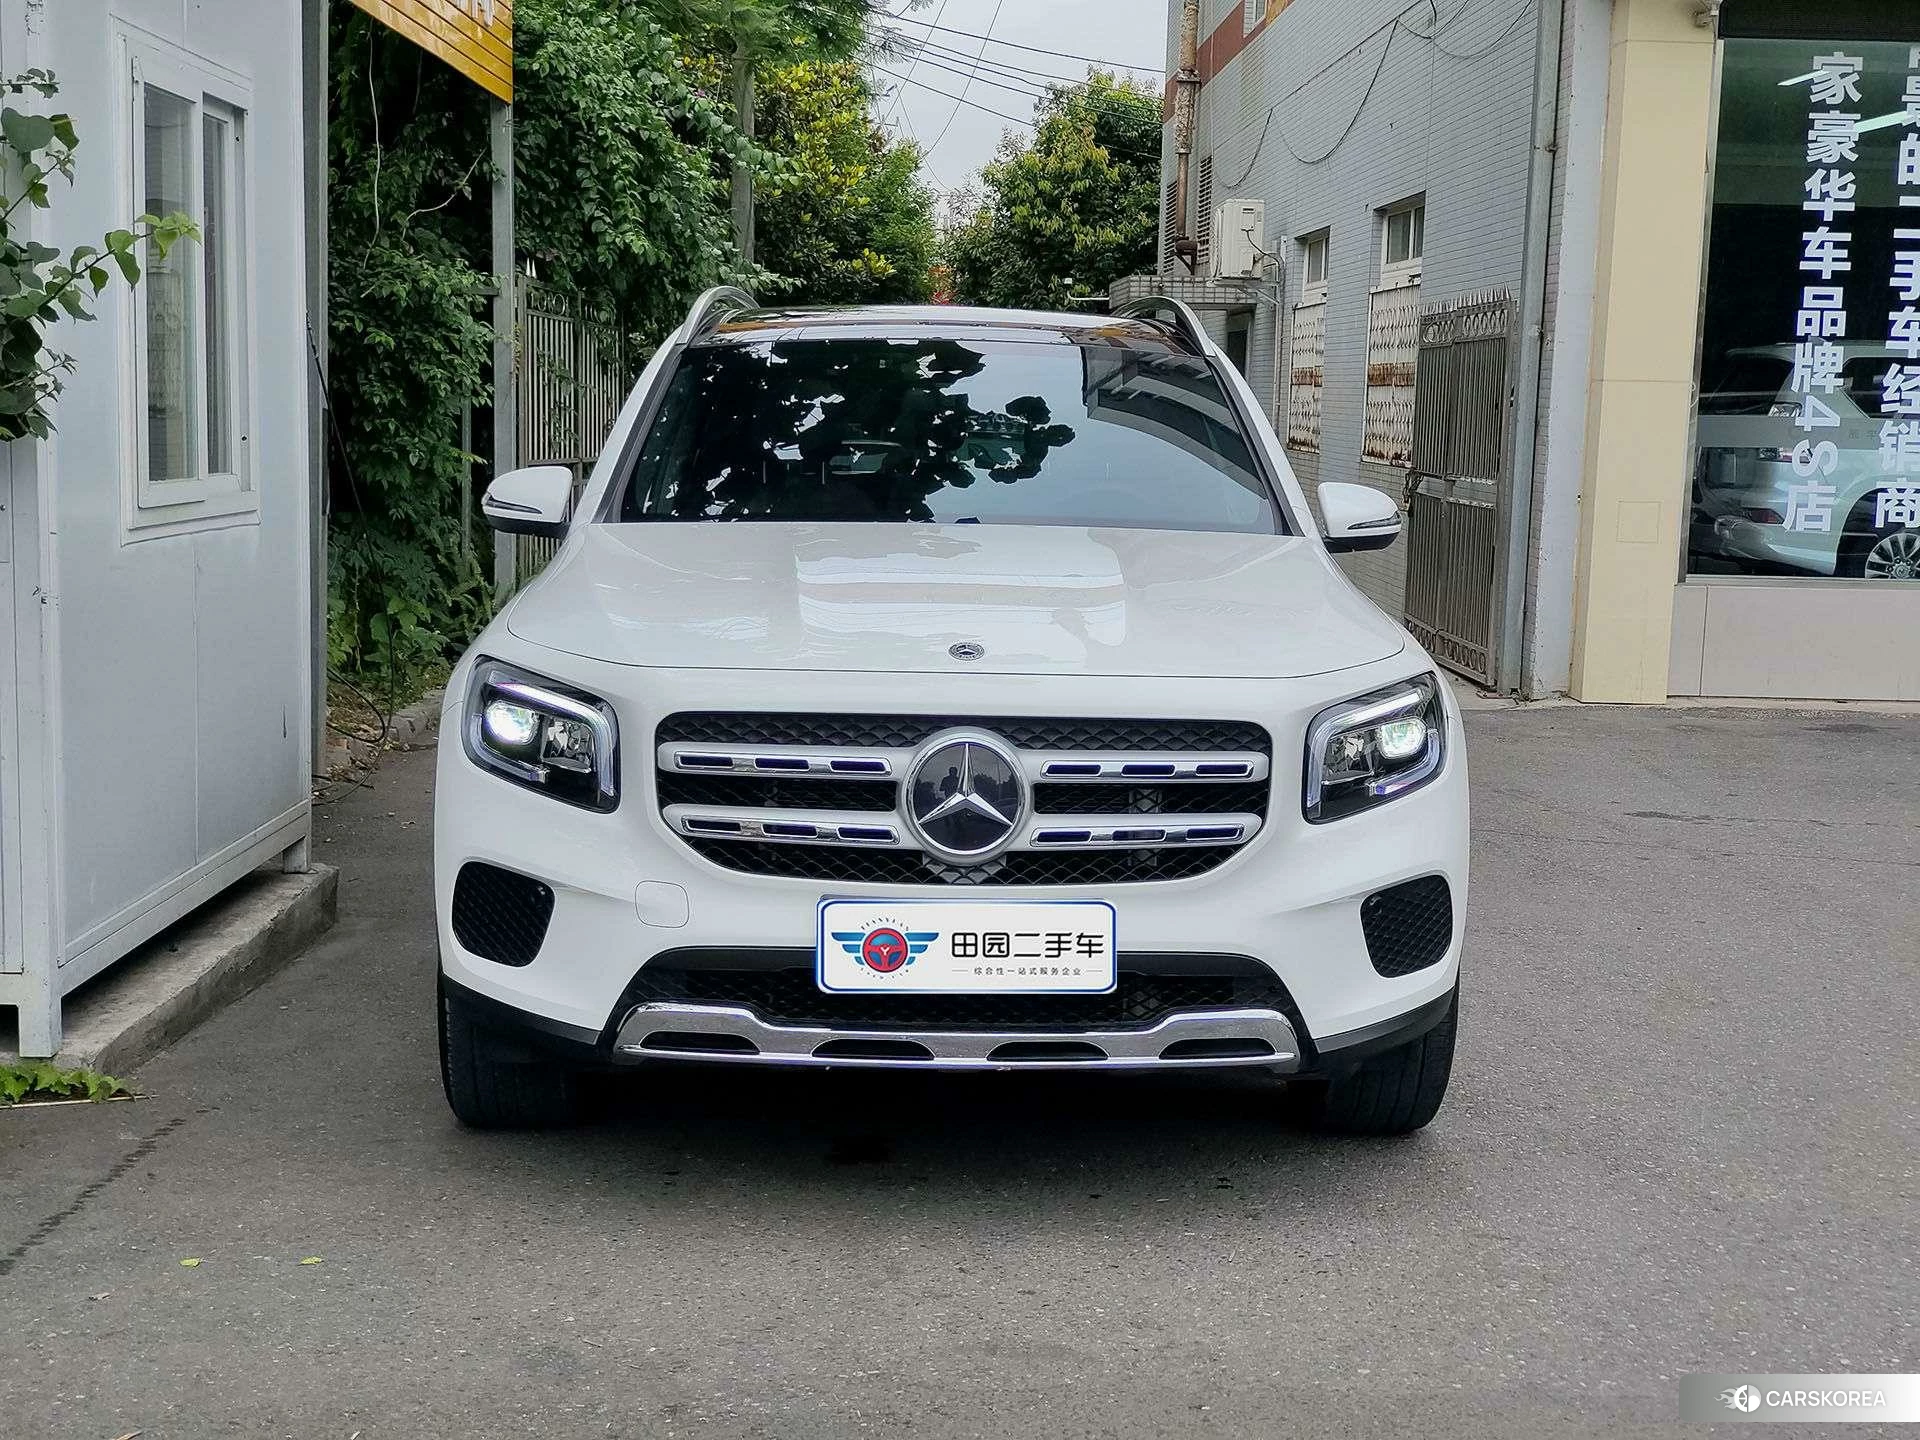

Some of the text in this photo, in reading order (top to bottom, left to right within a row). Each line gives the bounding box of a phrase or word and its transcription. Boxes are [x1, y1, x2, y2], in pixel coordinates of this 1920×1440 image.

[1782, 51, 1863, 533] 家豪华车品牌4S店
[951, 932, 1104, 958] 田园二手车
[974, 966, 1082, 977] 综合性一站式服务企业
